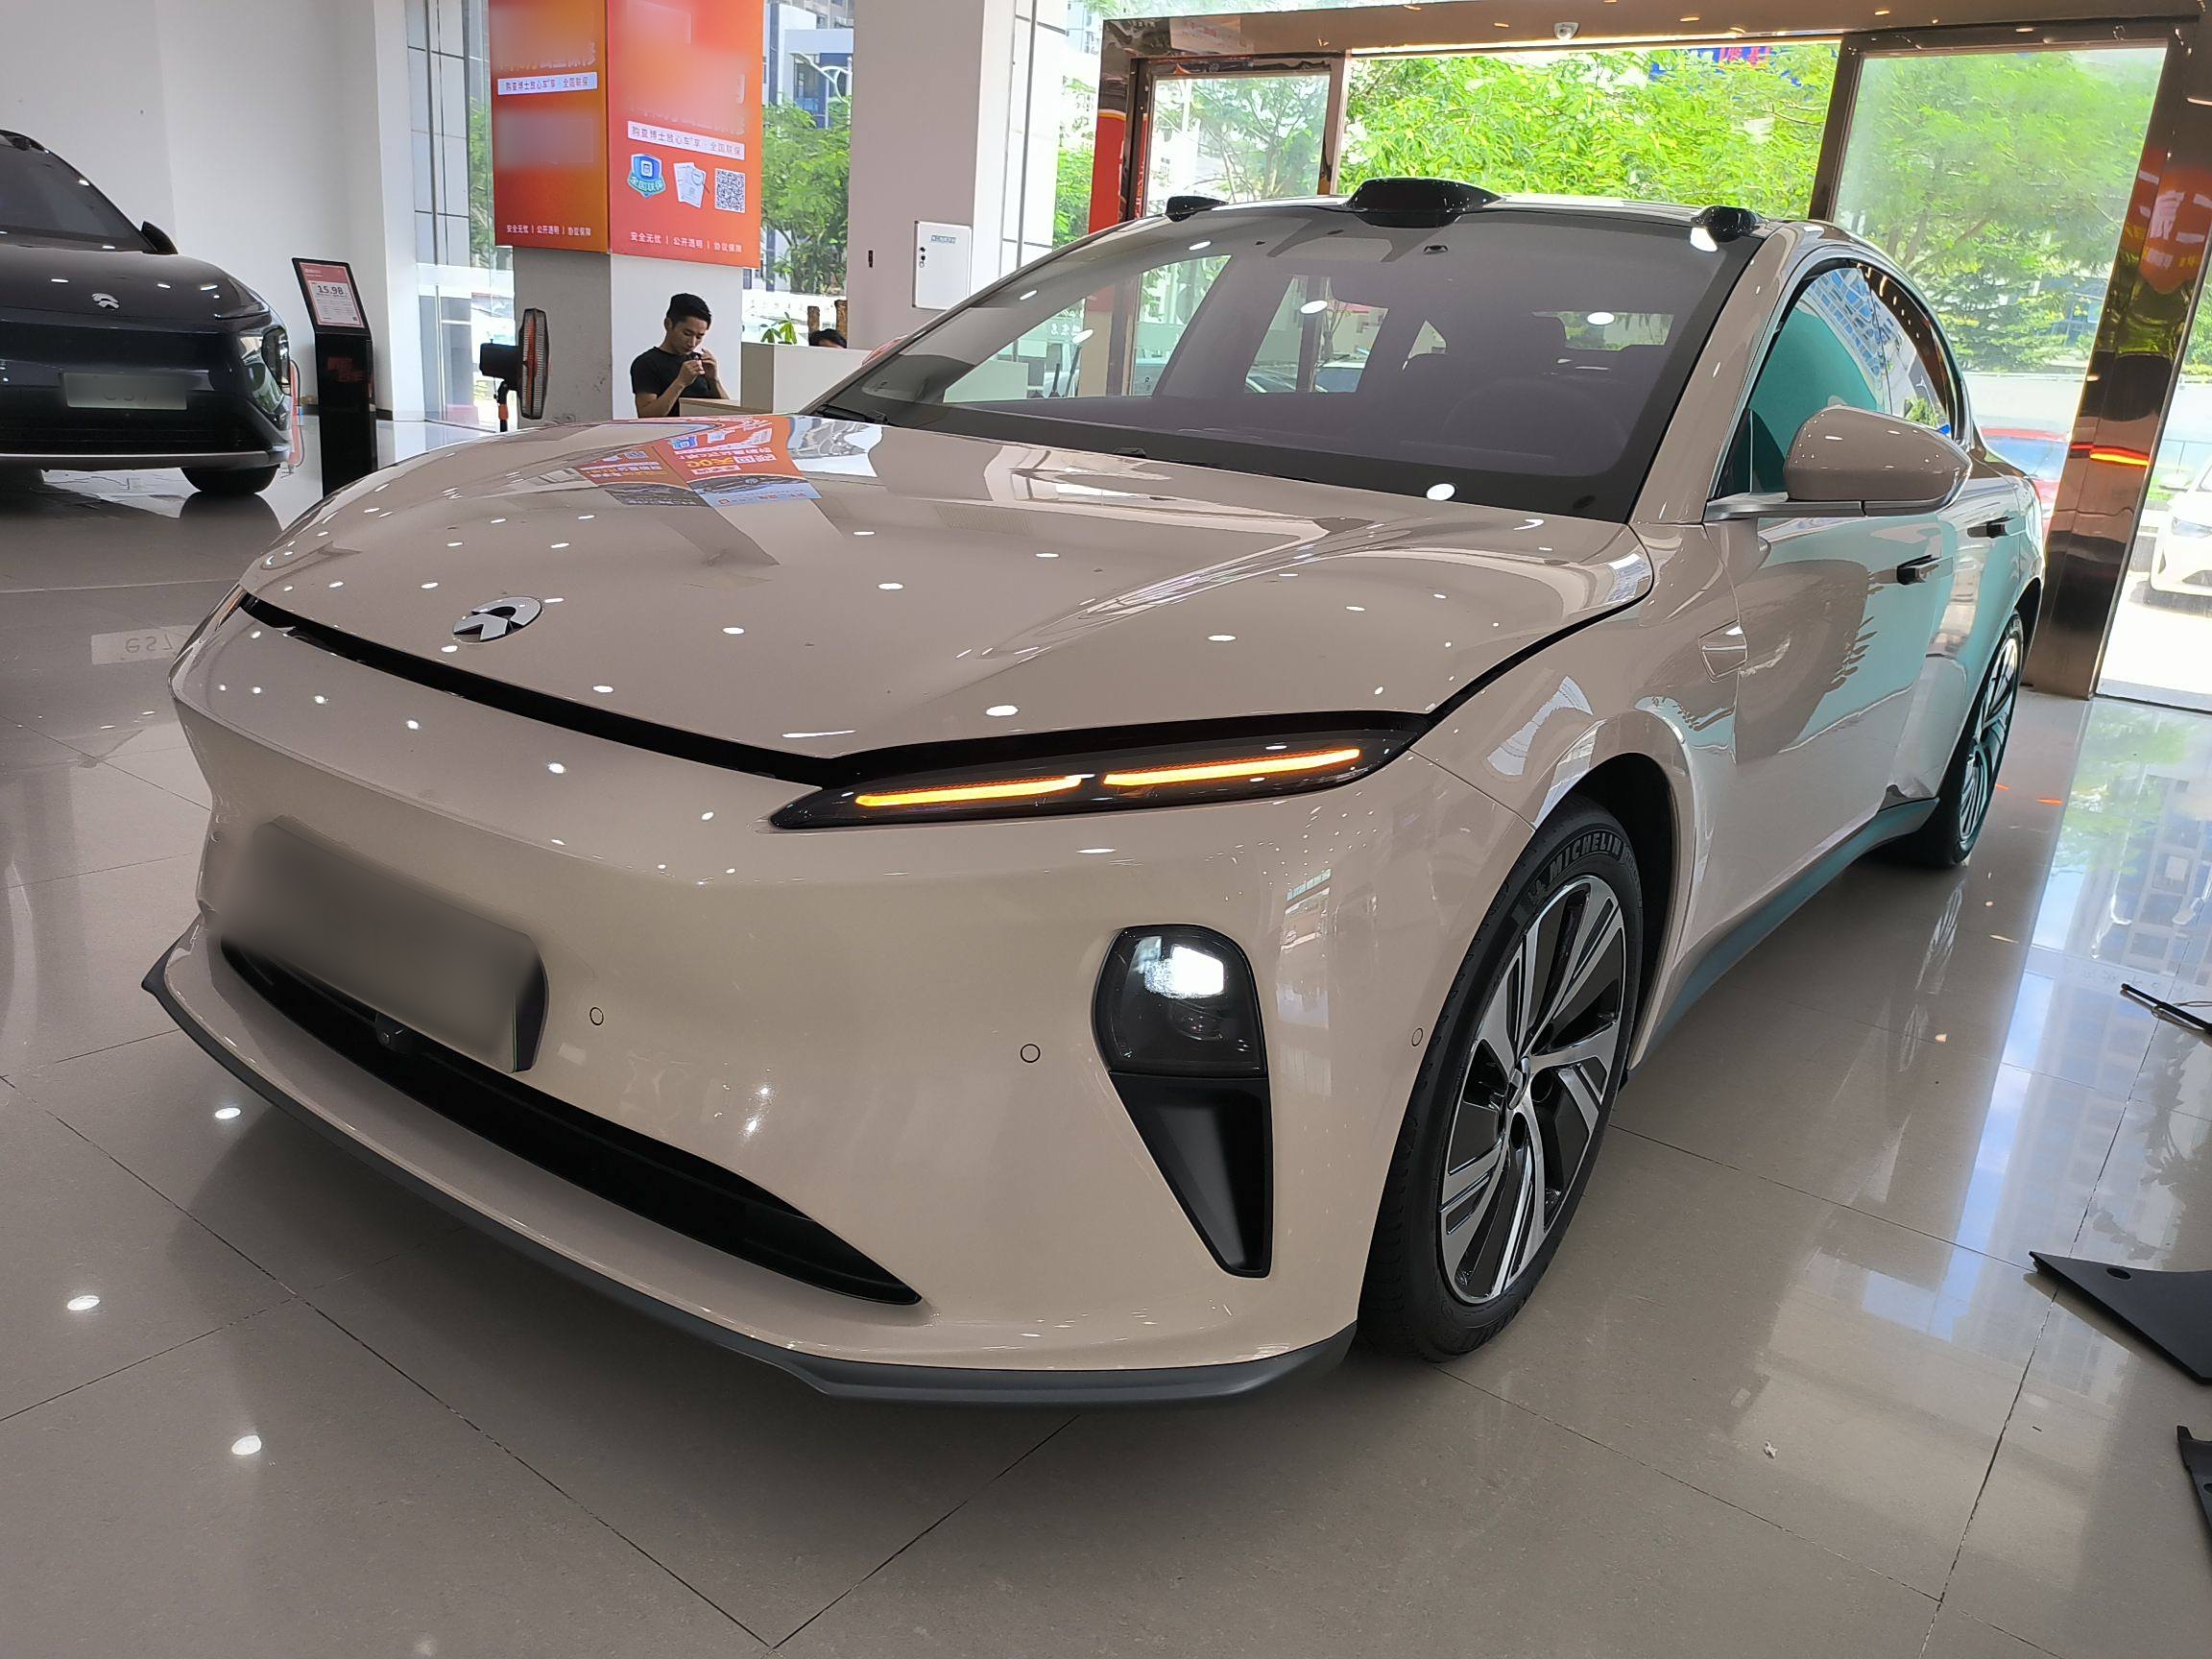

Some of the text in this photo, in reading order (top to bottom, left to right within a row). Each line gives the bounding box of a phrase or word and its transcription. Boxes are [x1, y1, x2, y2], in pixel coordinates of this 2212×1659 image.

[630, 231, 742, 253] 安全无忧 公开透明 协议保障
[317, 285, 345, 296] 15.98
[1549, 832, 1623, 883] MICHELIN
